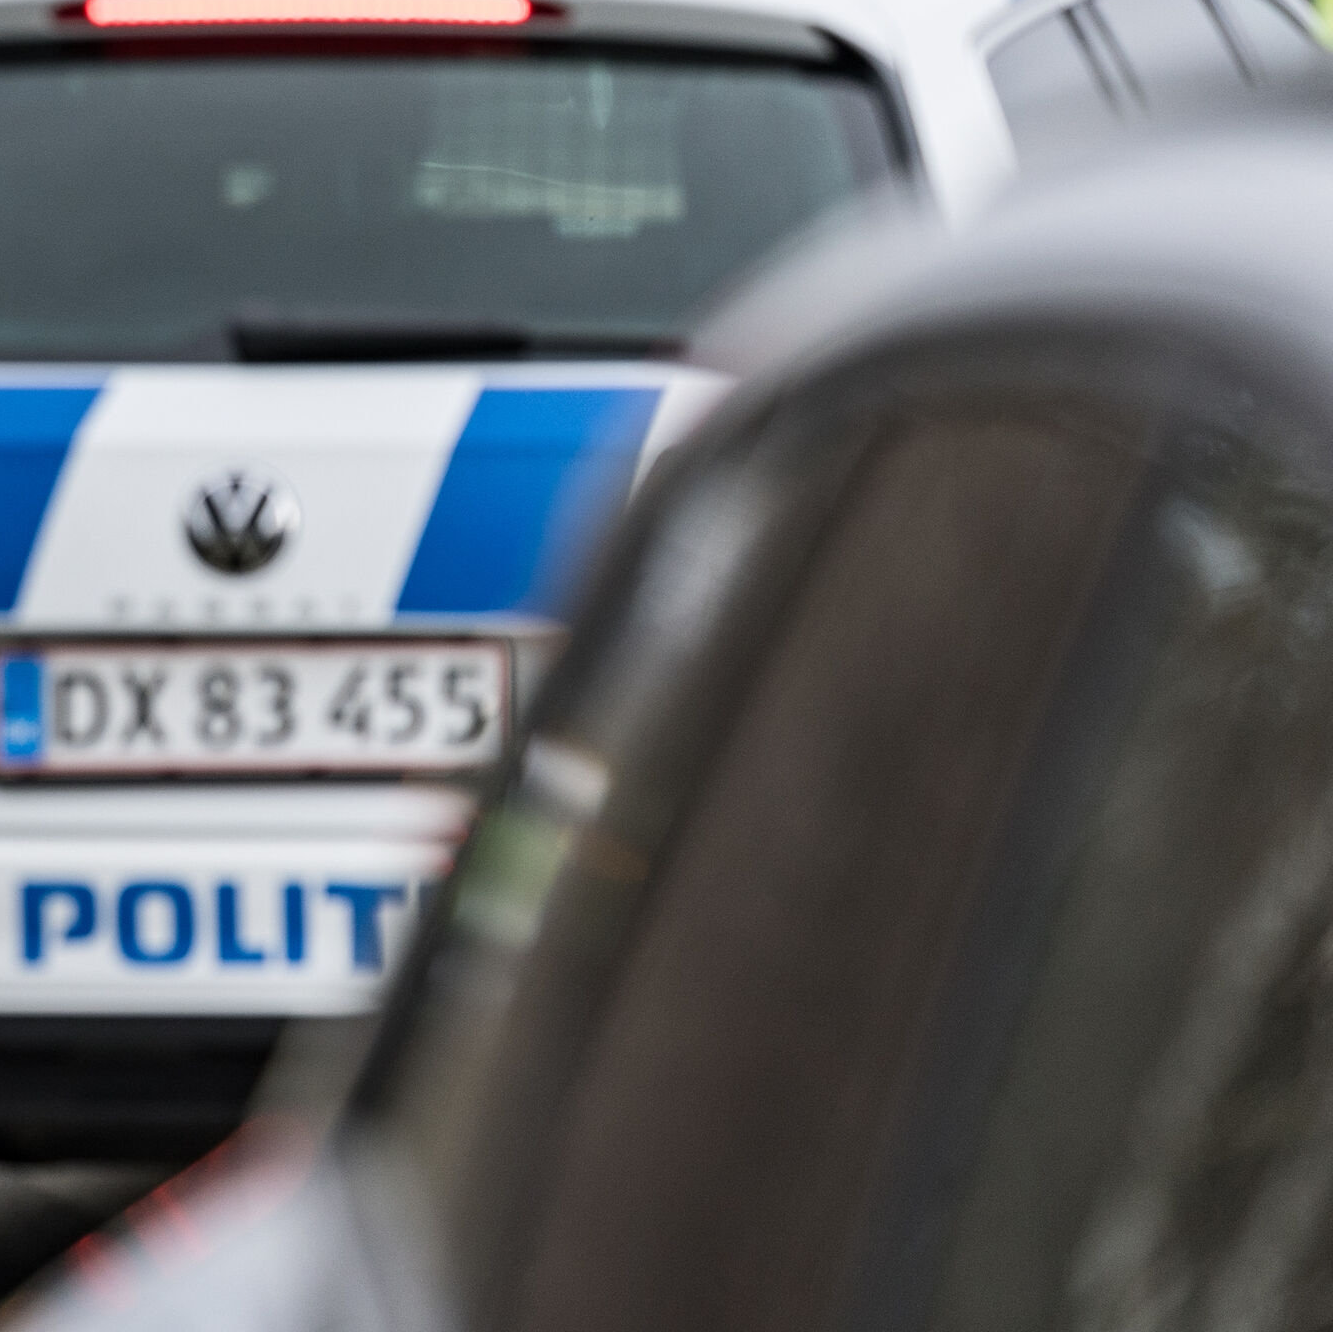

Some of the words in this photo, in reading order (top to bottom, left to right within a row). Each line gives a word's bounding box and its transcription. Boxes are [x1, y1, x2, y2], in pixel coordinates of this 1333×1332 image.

[53, 669, 166, 748] DX
[195, 666, 297, 746] 83
[327, 665, 490, 745] 455
[20, 881, 423, 970] POLIT
